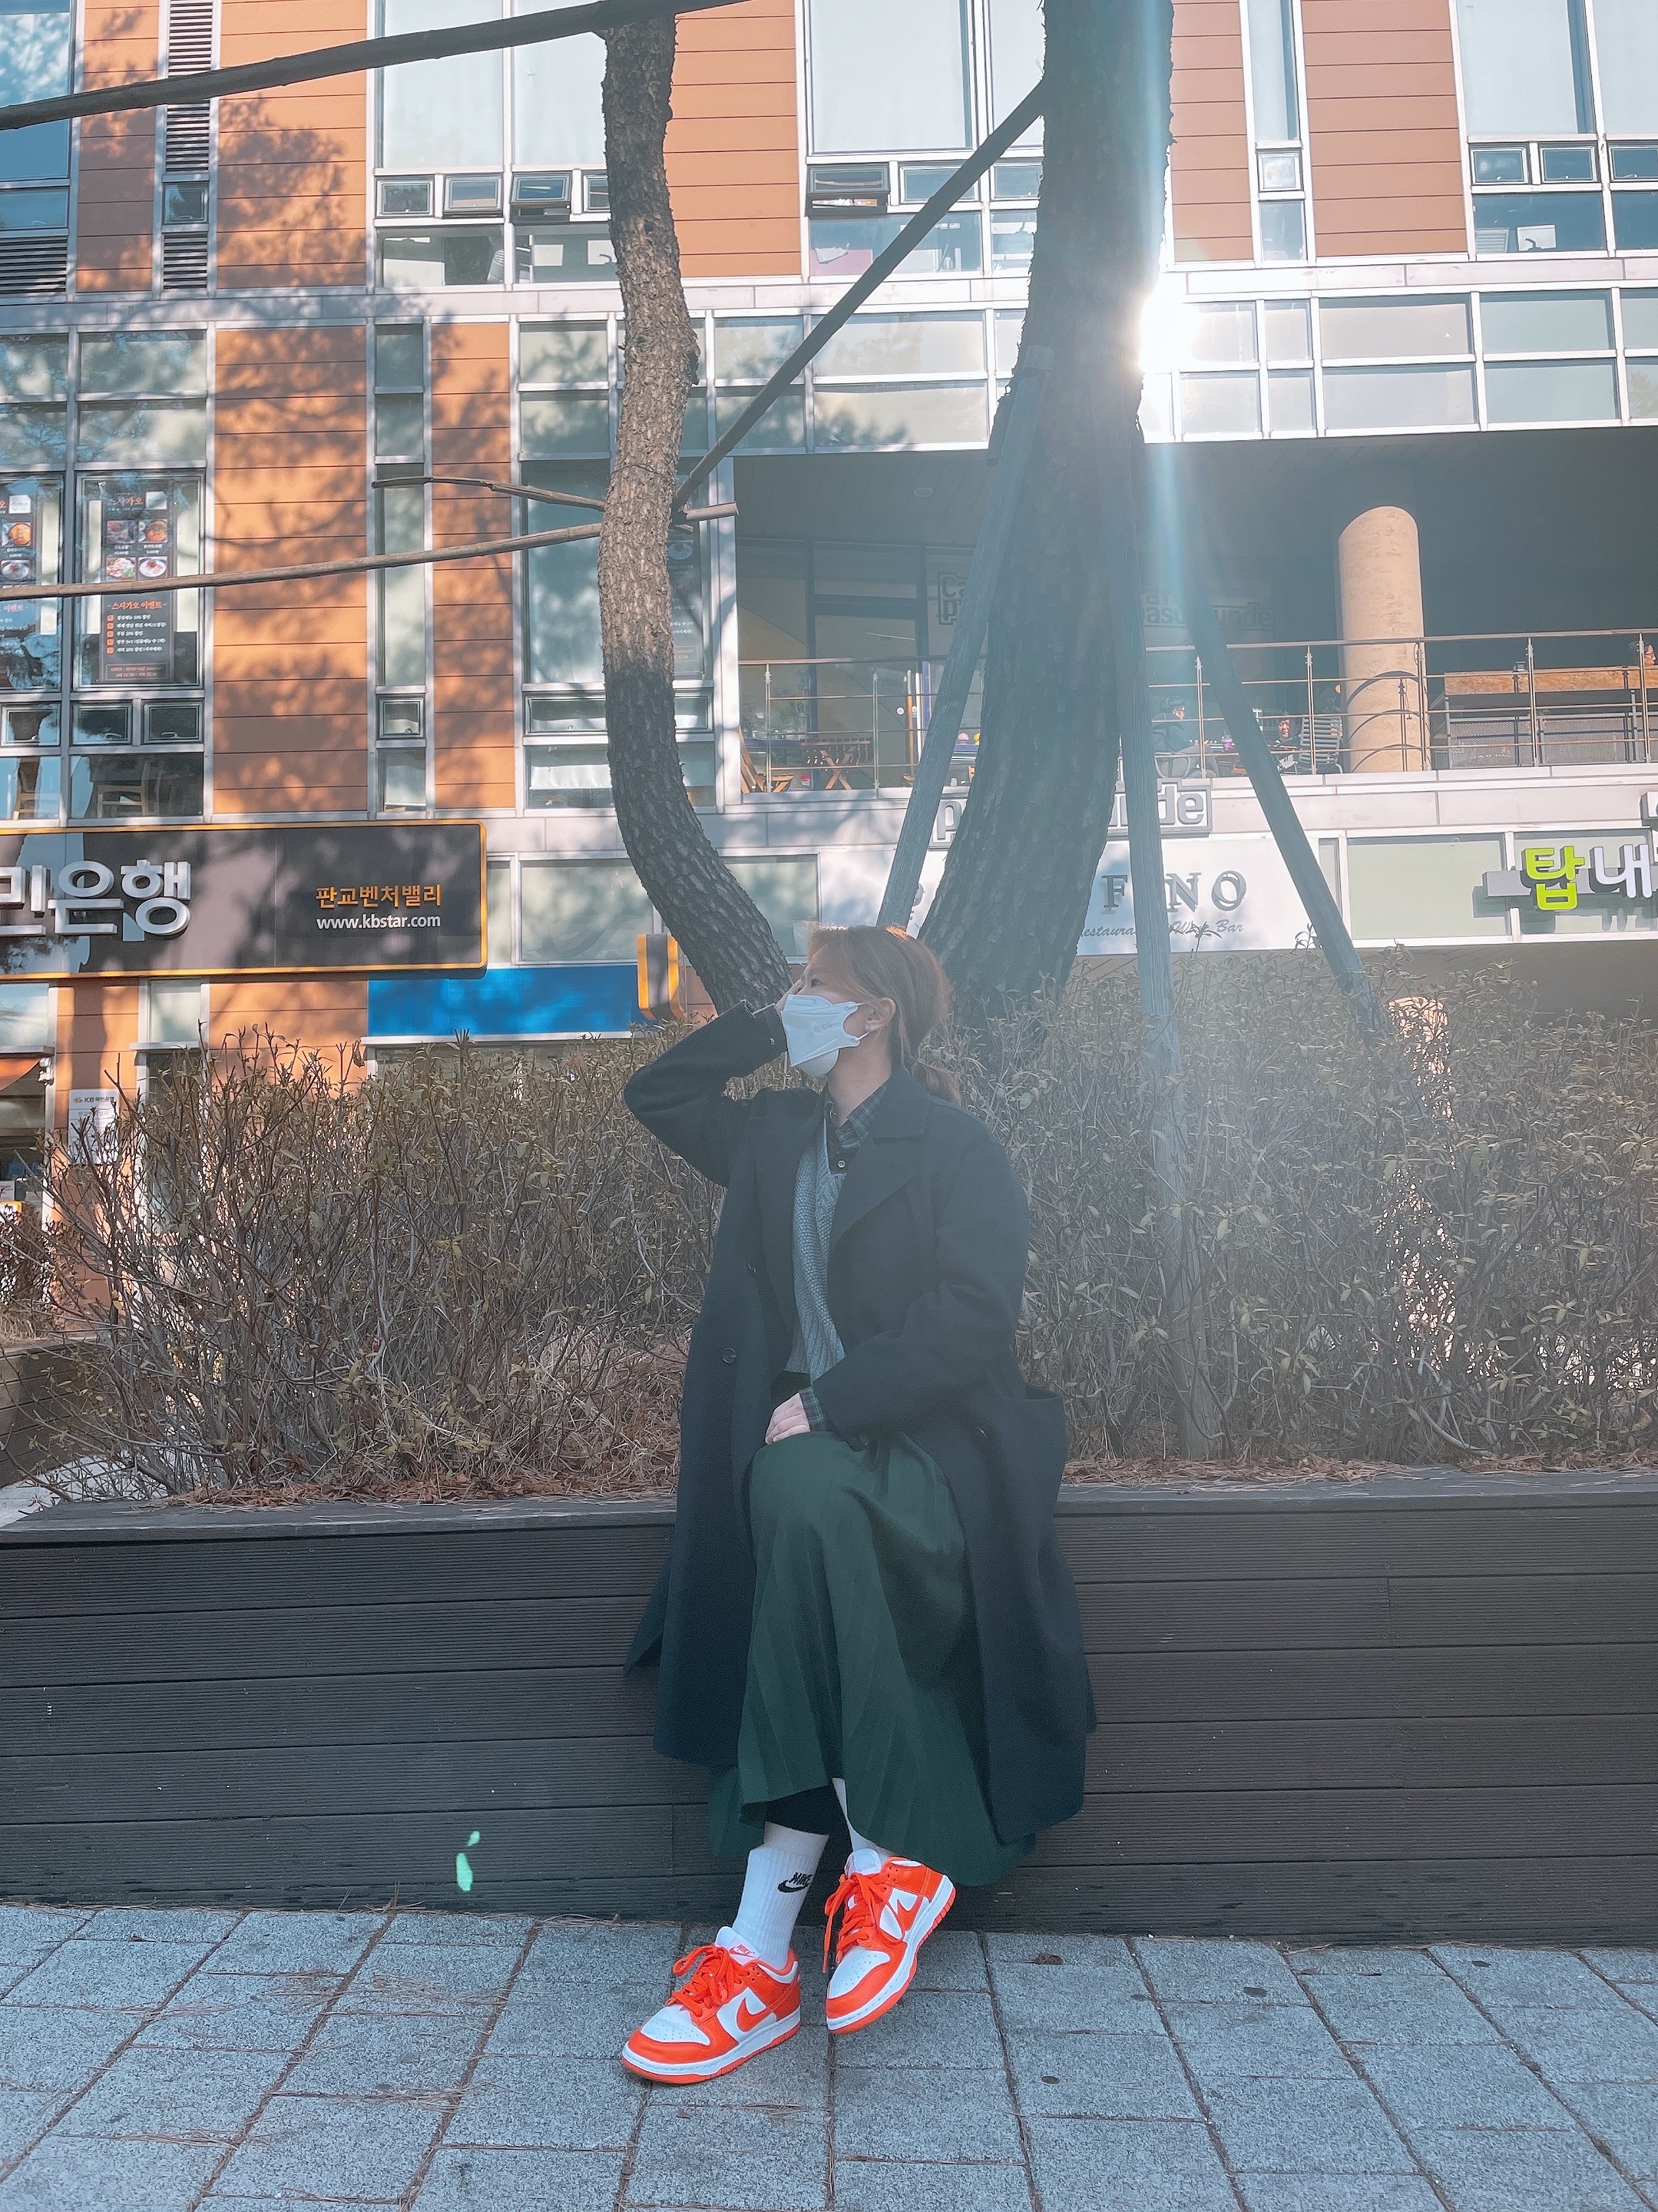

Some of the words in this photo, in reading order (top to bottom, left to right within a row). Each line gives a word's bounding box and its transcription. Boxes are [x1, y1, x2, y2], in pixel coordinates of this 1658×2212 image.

[316, 884, 442, 909] 판교벤처밸리
[316, 913, 442, 930] www.kbstar.com
[1214, 919, 1244, 933] Bar
